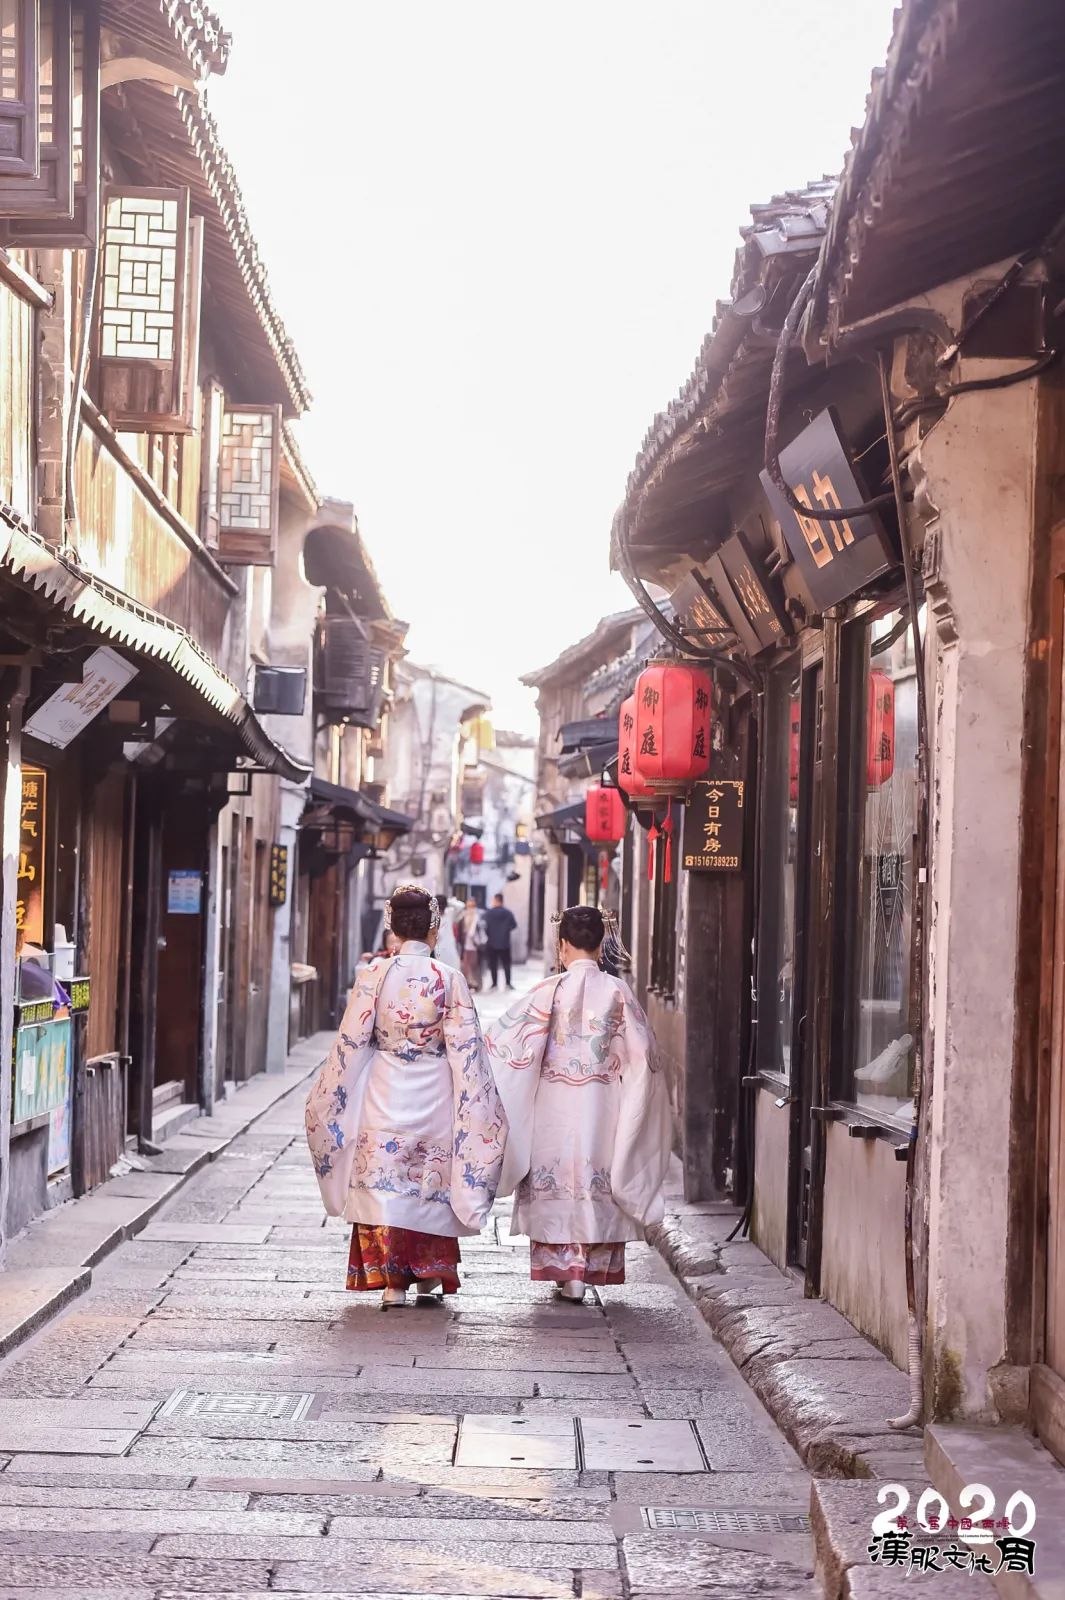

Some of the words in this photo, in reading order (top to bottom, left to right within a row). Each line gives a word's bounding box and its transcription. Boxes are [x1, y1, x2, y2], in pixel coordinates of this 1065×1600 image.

[640, 686, 660, 757] 御庭
[692, 687, 709, 759] 御庭
[702, 788, 725, 853] 今日有房
[694, 856, 738, 867] 15167389233
